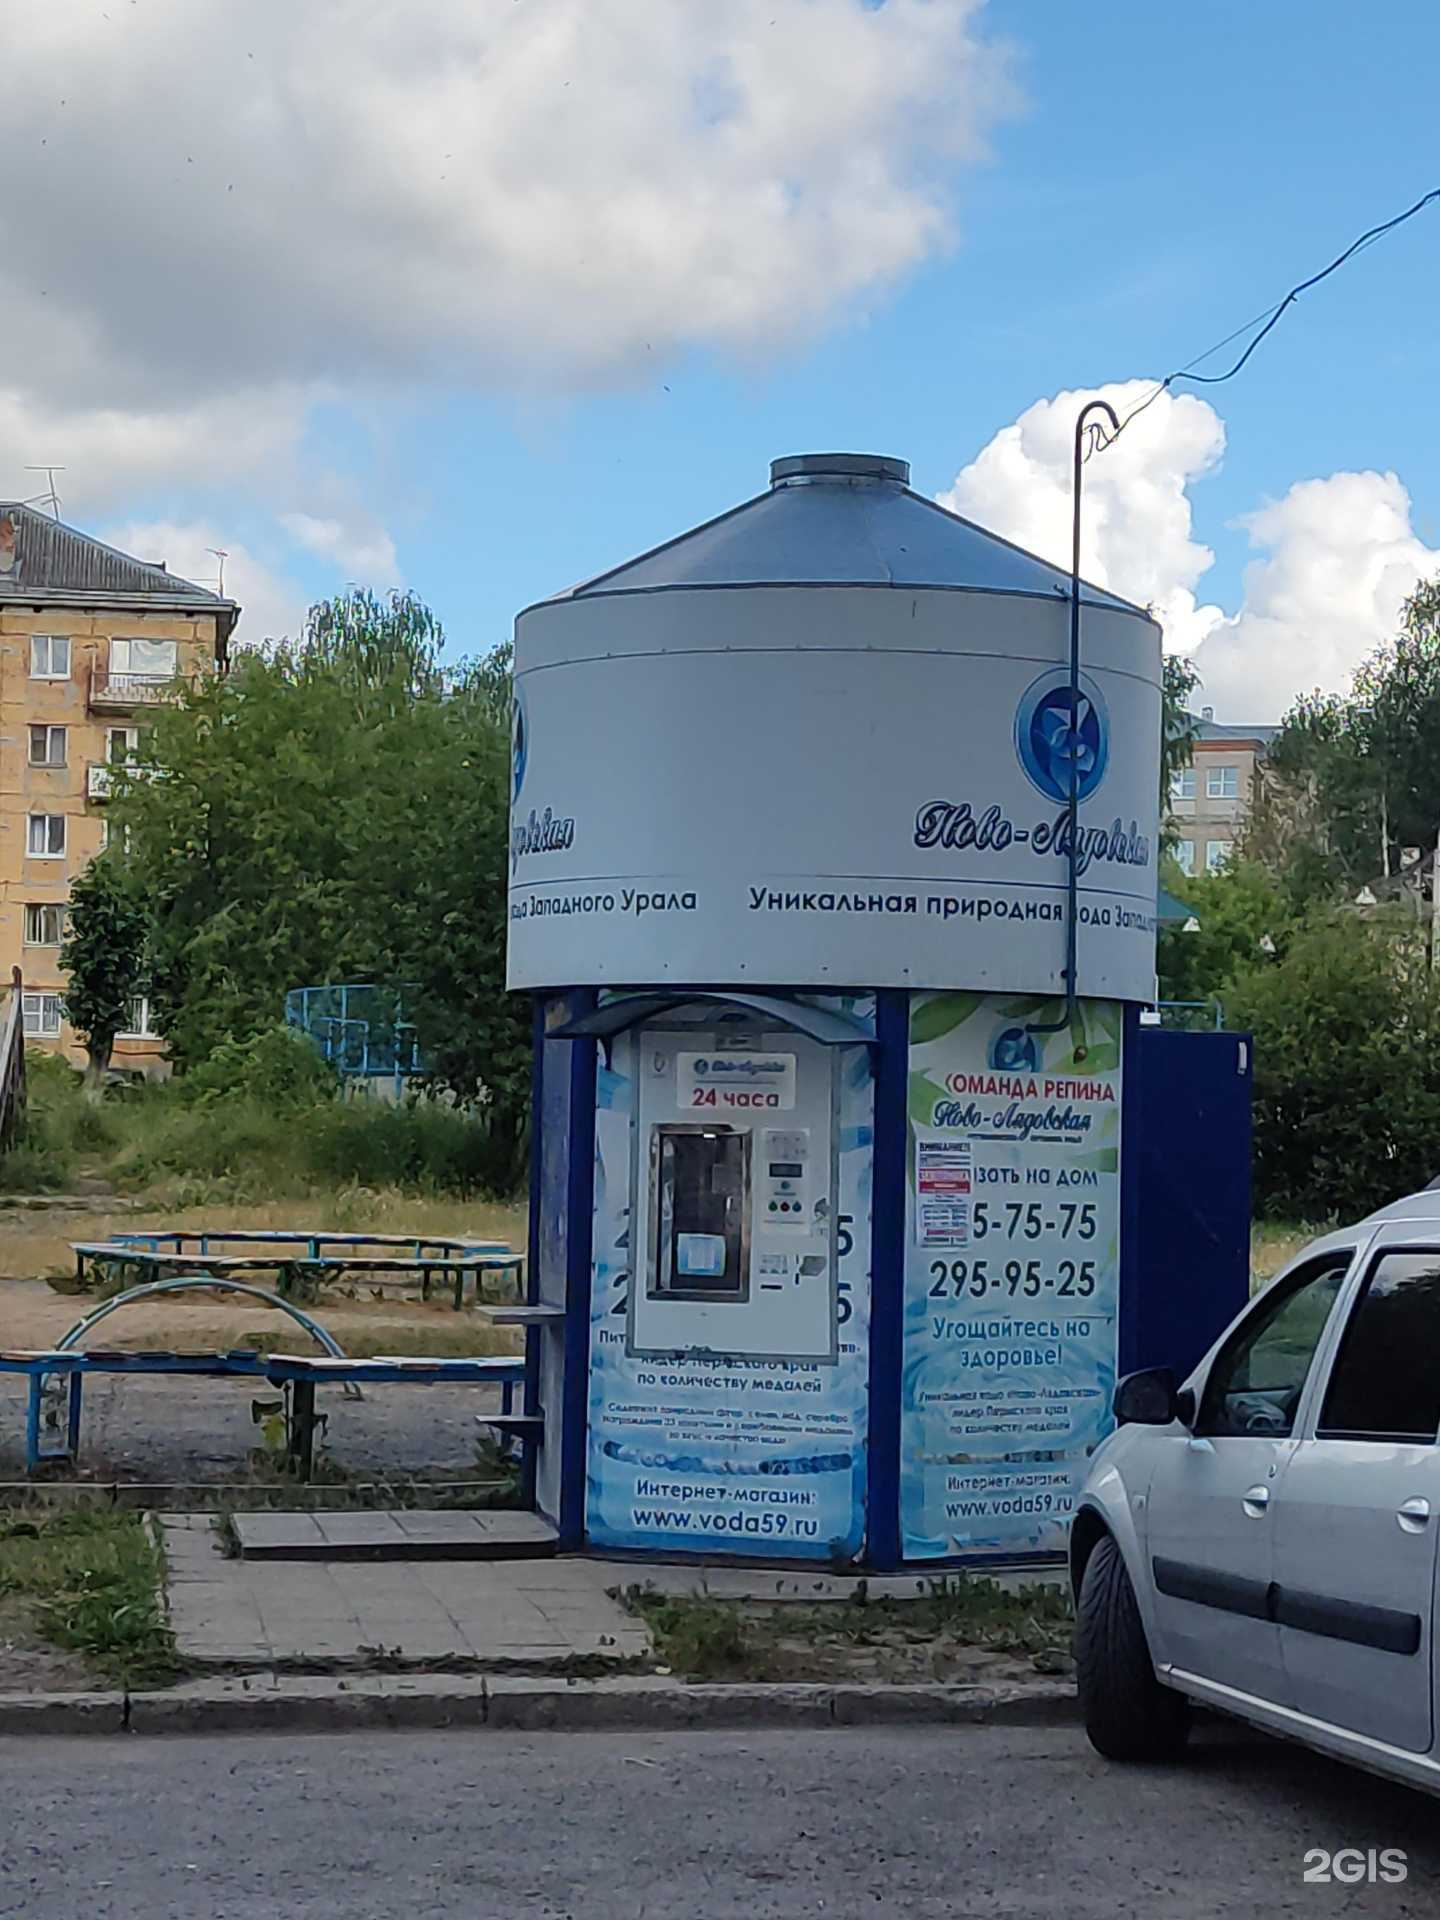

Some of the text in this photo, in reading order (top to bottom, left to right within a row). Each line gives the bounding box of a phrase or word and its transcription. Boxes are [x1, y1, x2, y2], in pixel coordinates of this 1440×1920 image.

[529, 895, 615, 917] Западного
[620, 889, 697, 916] Урала
[749, 887, 917, 913] Уникальная
[927, 896, 1062, 920] природная
[1074, 905, 1110, 926] ода
[692, 1088, 779, 1107] 24 часа
[1044, 1079, 1115, 1102] РЕПИНА
[1026, 1168, 1050, 1184] на
[1056, 1171, 1097, 1187] дом
[973, 1203, 1096, 1239] 5-75-75
[929, 1261, 1096, 1297] 295-95-25
[933, 1316, 1060, 1340] Угощайтесь
[961, 1344, 1062, 1370] здоровье!
[638, 1374, 821, 1393] по количеству медалей
[637, 1479, 816, 1505] Интернет-магазин:
[946, 1494, 1073, 1518] www.voda59.ru
[633, 1509, 818, 1536] www.voda59.ru
